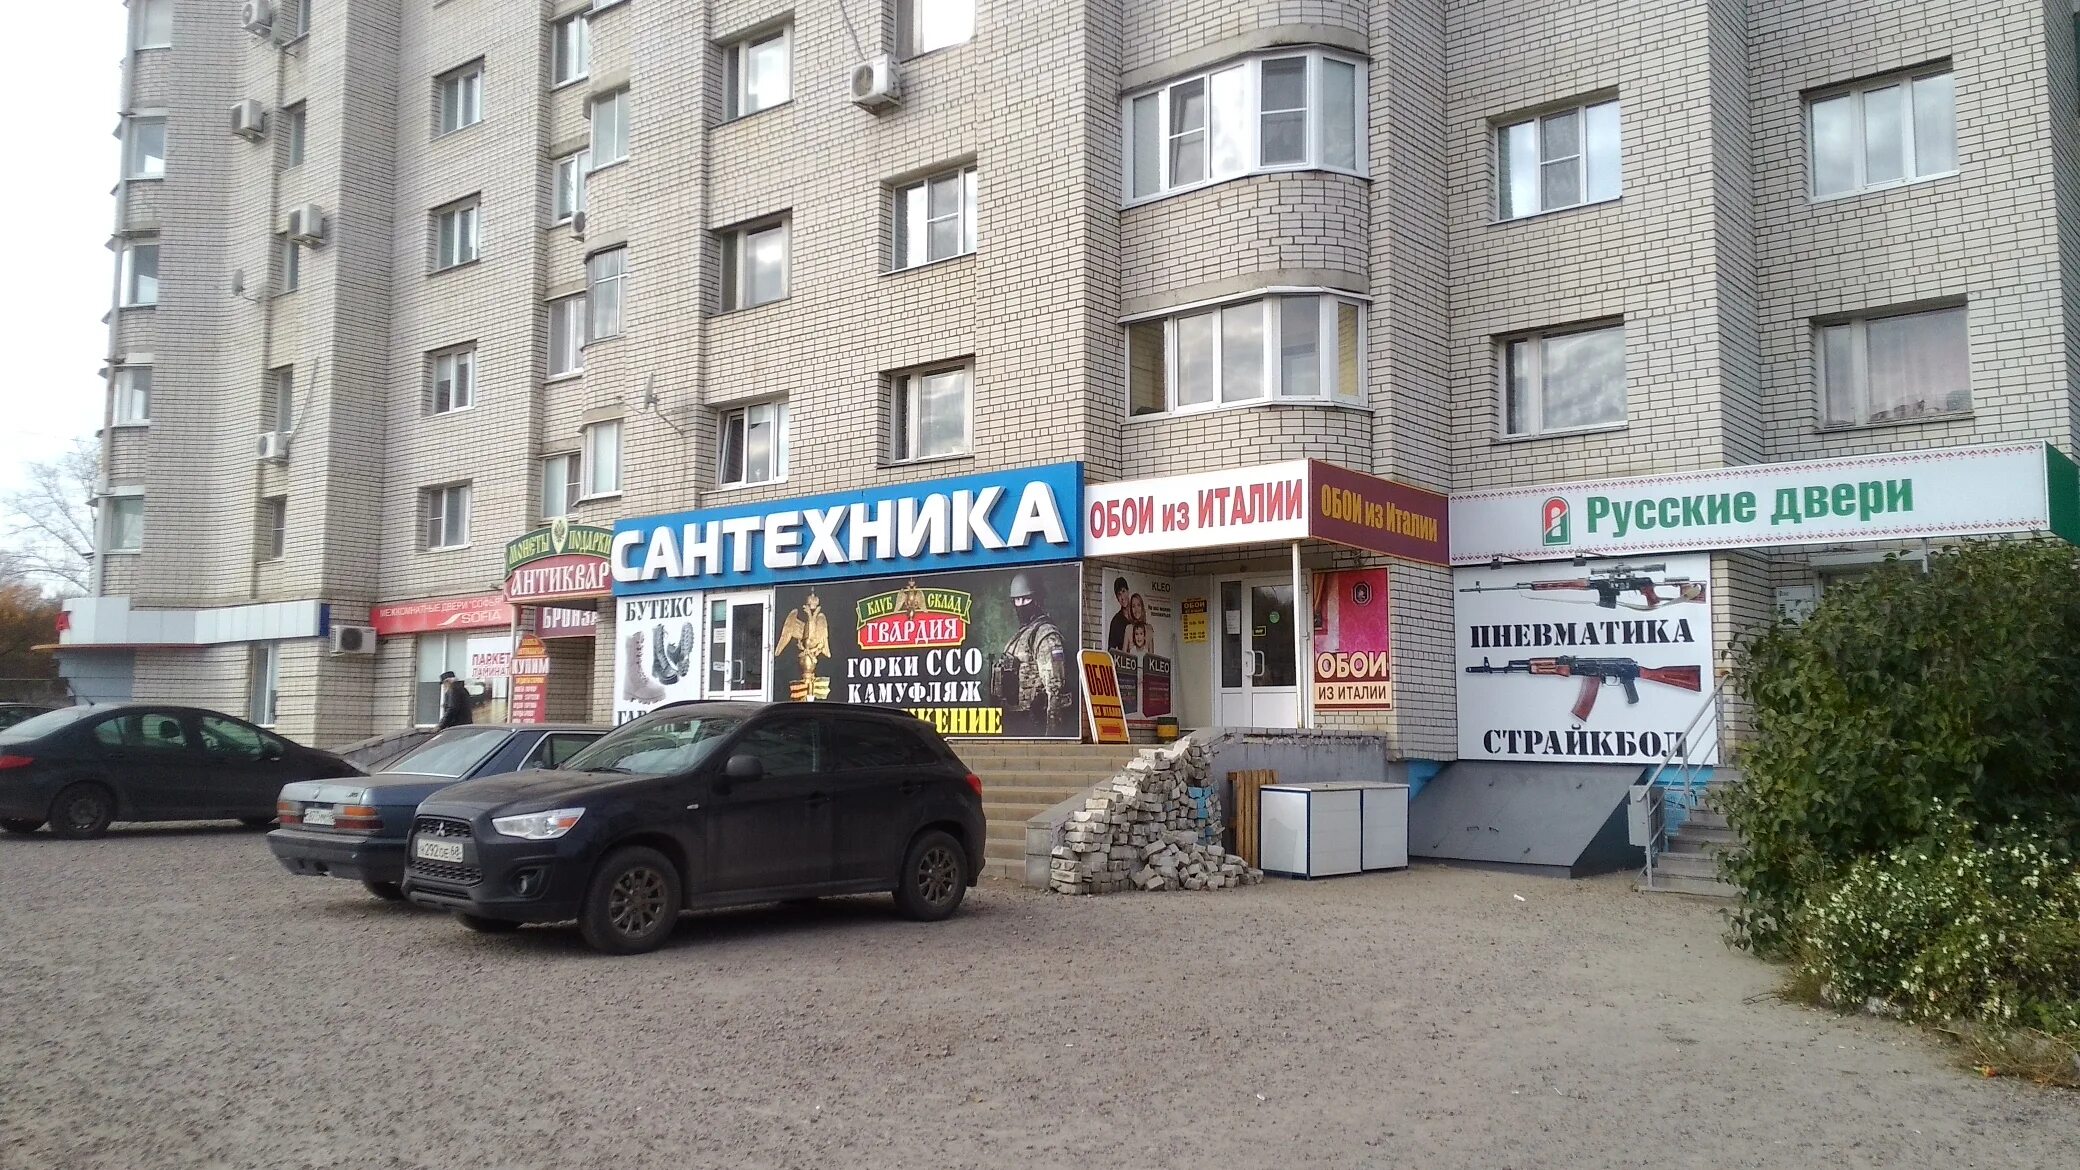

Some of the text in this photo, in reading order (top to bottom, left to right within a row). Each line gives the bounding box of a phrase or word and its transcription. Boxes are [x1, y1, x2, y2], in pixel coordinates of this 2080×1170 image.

[1090, 478, 1302, 539] ОБОИ из ИТАЛИИ
[1321, 484, 1438, 543] ОБОИ из Италии
[1587, 478, 1914, 538] Русские двери
[611, 481, 1069, 583] САНТЕХНИКА
[509, 529, 613, 565] МОНЕТЫ ПОДАРКИ
[511, 562, 610, 596] АНТИКВАР
[1151, 581, 1171, 593] KLEO
[380, 603, 441, 617] МЕЖКОМНАТНЫЕ
[441, 600, 468, 612] ДВЕРИ
[461, 610, 502, 624] SOFIA
[625, 596, 693, 622] БУТЕКС
[866, 593, 962, 616] КЛУБ СКЛАД
[1183, 601, 1205, 609] ОБОИ
[866, 617, 959, 645] ГВАРДИЯ
[1470, 618, 1695, 648] ПНЕВМАТИКА
[472, 653, 511, 666] ПАРКЕТ
[472, 666, 511, 678] ЛАМИНАТ
[511, 658, 550, 675] КУПИМ
[847, 648, 983, 678] ГОРКИ ССО
[1114, 654, 1137, 671] KLEO
[1149, 658, 1170, 674] KLEO
[1317, 651, 1387, 679] ОБОИ
[847, 681, 982, 704] КАМУФЛЯЖ
[1085, 663, 1118, 698] ОБОИ
[1318, 685, 1387, 700] ИЗ ИТАЛИИ
[1483, 723, 1685, 758] СТРАЙКБОЛ
